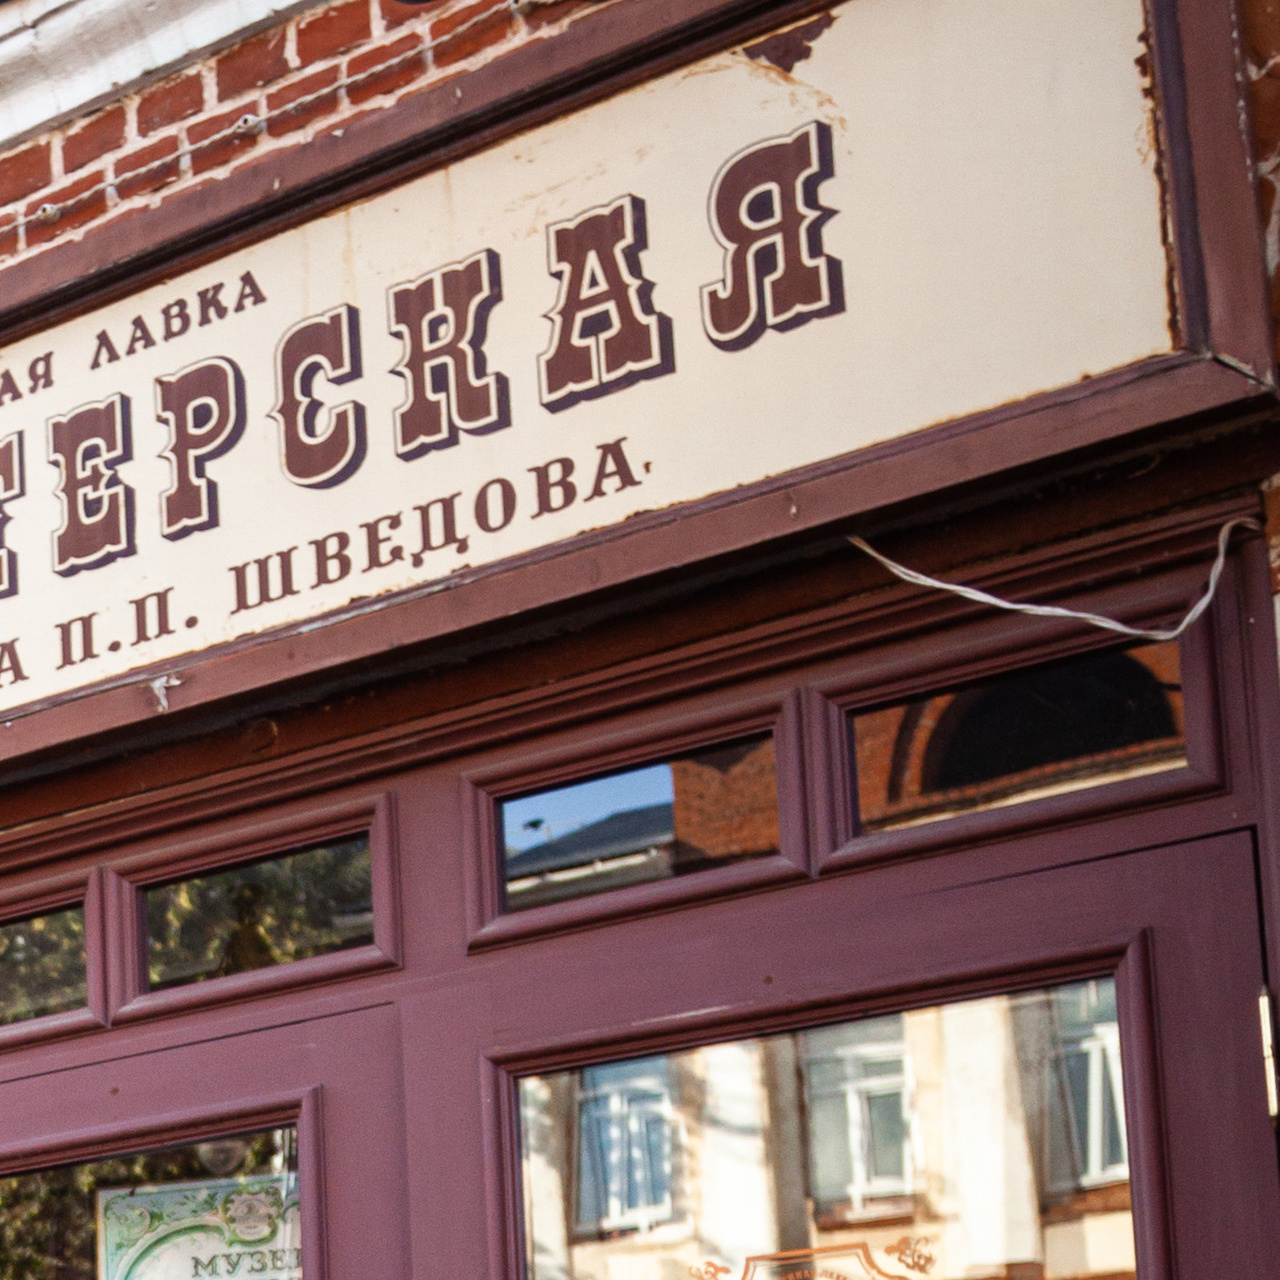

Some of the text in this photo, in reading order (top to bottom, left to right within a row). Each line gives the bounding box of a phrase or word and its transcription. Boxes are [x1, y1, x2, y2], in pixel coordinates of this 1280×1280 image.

[90, 269, 269, 365] ЛАВКА
[58, 590, 199, 662] П.П.
[229, 435, 642, 617] ШВЕДОВА
